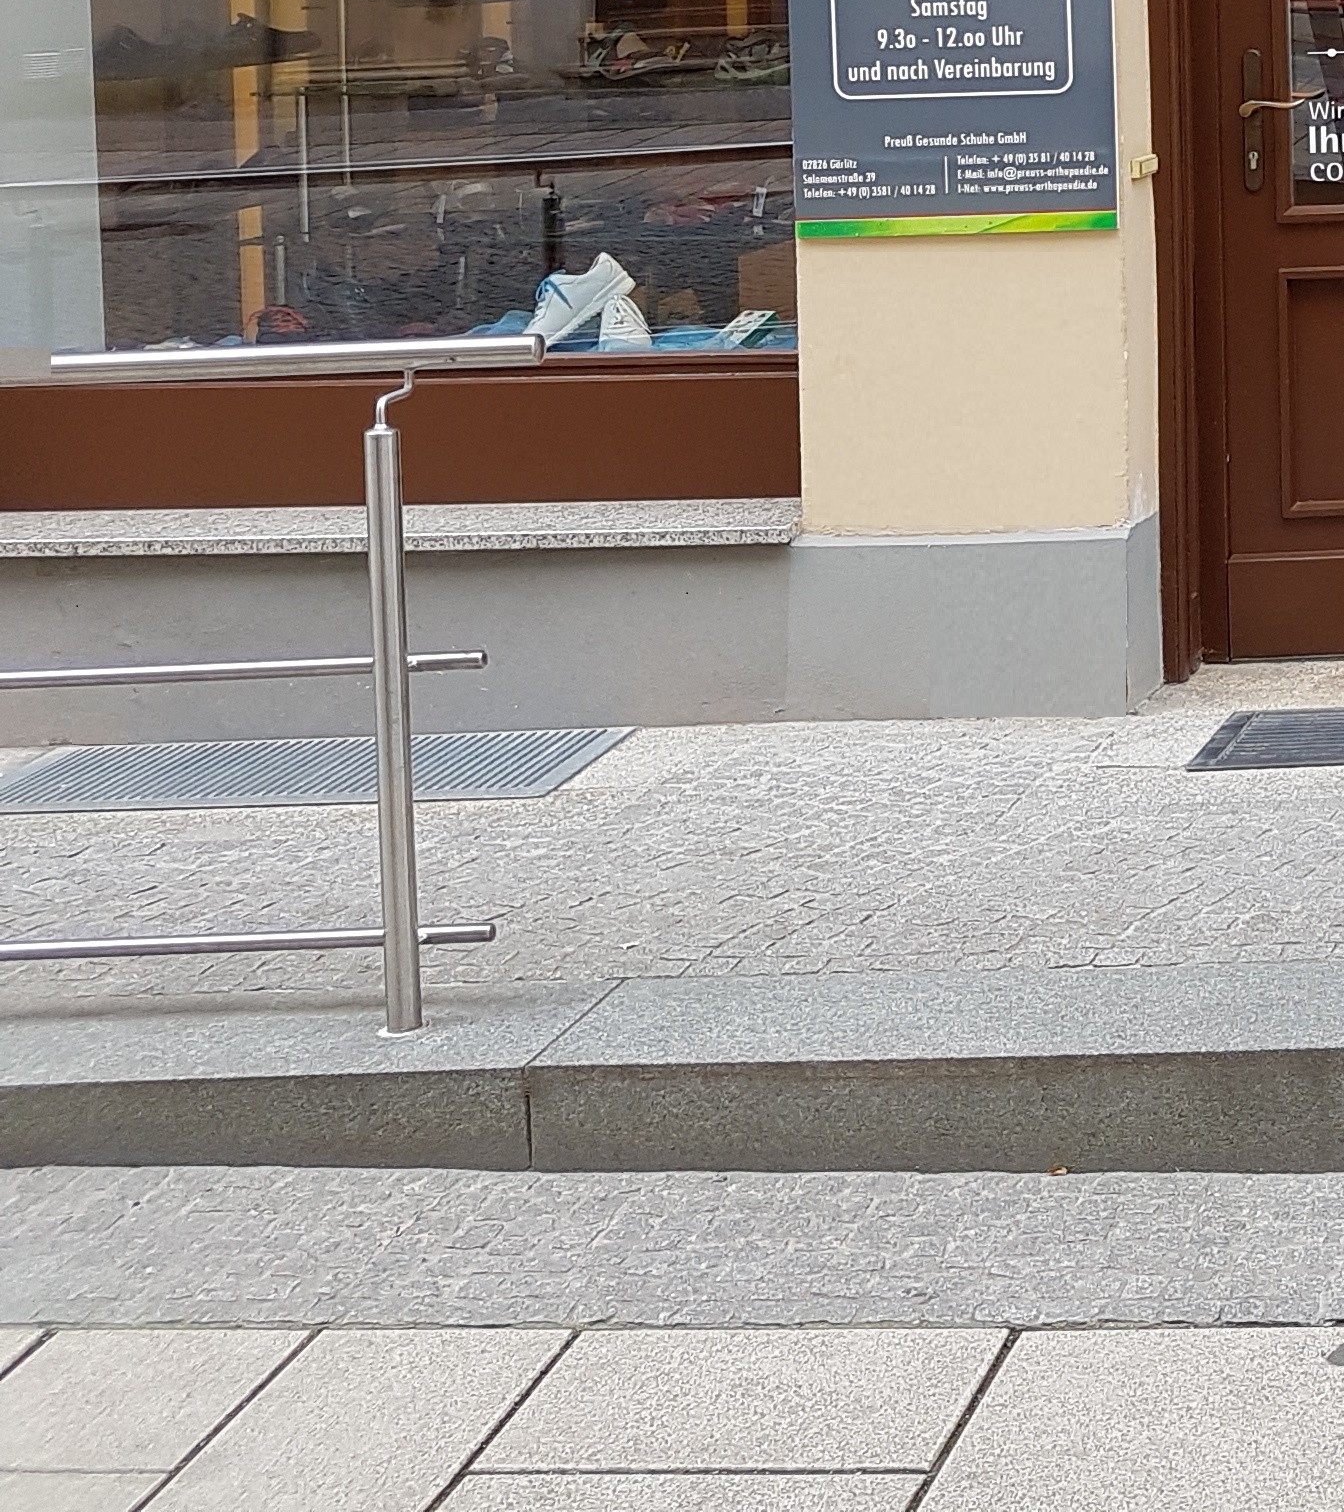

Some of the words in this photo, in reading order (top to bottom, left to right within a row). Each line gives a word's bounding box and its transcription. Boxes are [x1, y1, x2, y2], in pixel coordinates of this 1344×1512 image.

[992, 26, 1023, 46] Uhr
[848, 61, 881, 82] und
[887, 60, 928, 80] nach
[934, 59, 1056, 81] Vereinbarung
[1308, 101, 1344, 121] Wir
[884, 135, 913, 148] Preuß
[916, 134, 958, 147] Gesunde
[960, 133, 995, 146] Schuhe
[997, 132, 1027, 145] GmbH
[957, 155, 989, 165] Telefon:
[991, 155, 1000, 164] +
[1003, 153, 1013, 163] 49
[1015, 153, 1027, 165] (0)
[1028, 152, 1039, 163] 35
[1040, 152, 1050, 162] 81
[1059, 151, 1070, 162] 40
[1073, 151, 1082, 162] 14
[1084, 151, 1095, 161] 28
[865, 172, 876, 182] 39
[803, 188, 836, 198] Telefon:
[838, 187, 857, 197] +49
[858, 186, 870, 199] (0)
[871, 186, 891, 197] 3581
[900, 185, 911, 195] 40
[913, 185, 923, 195] 14
[925, 184, 936, 195] 28
